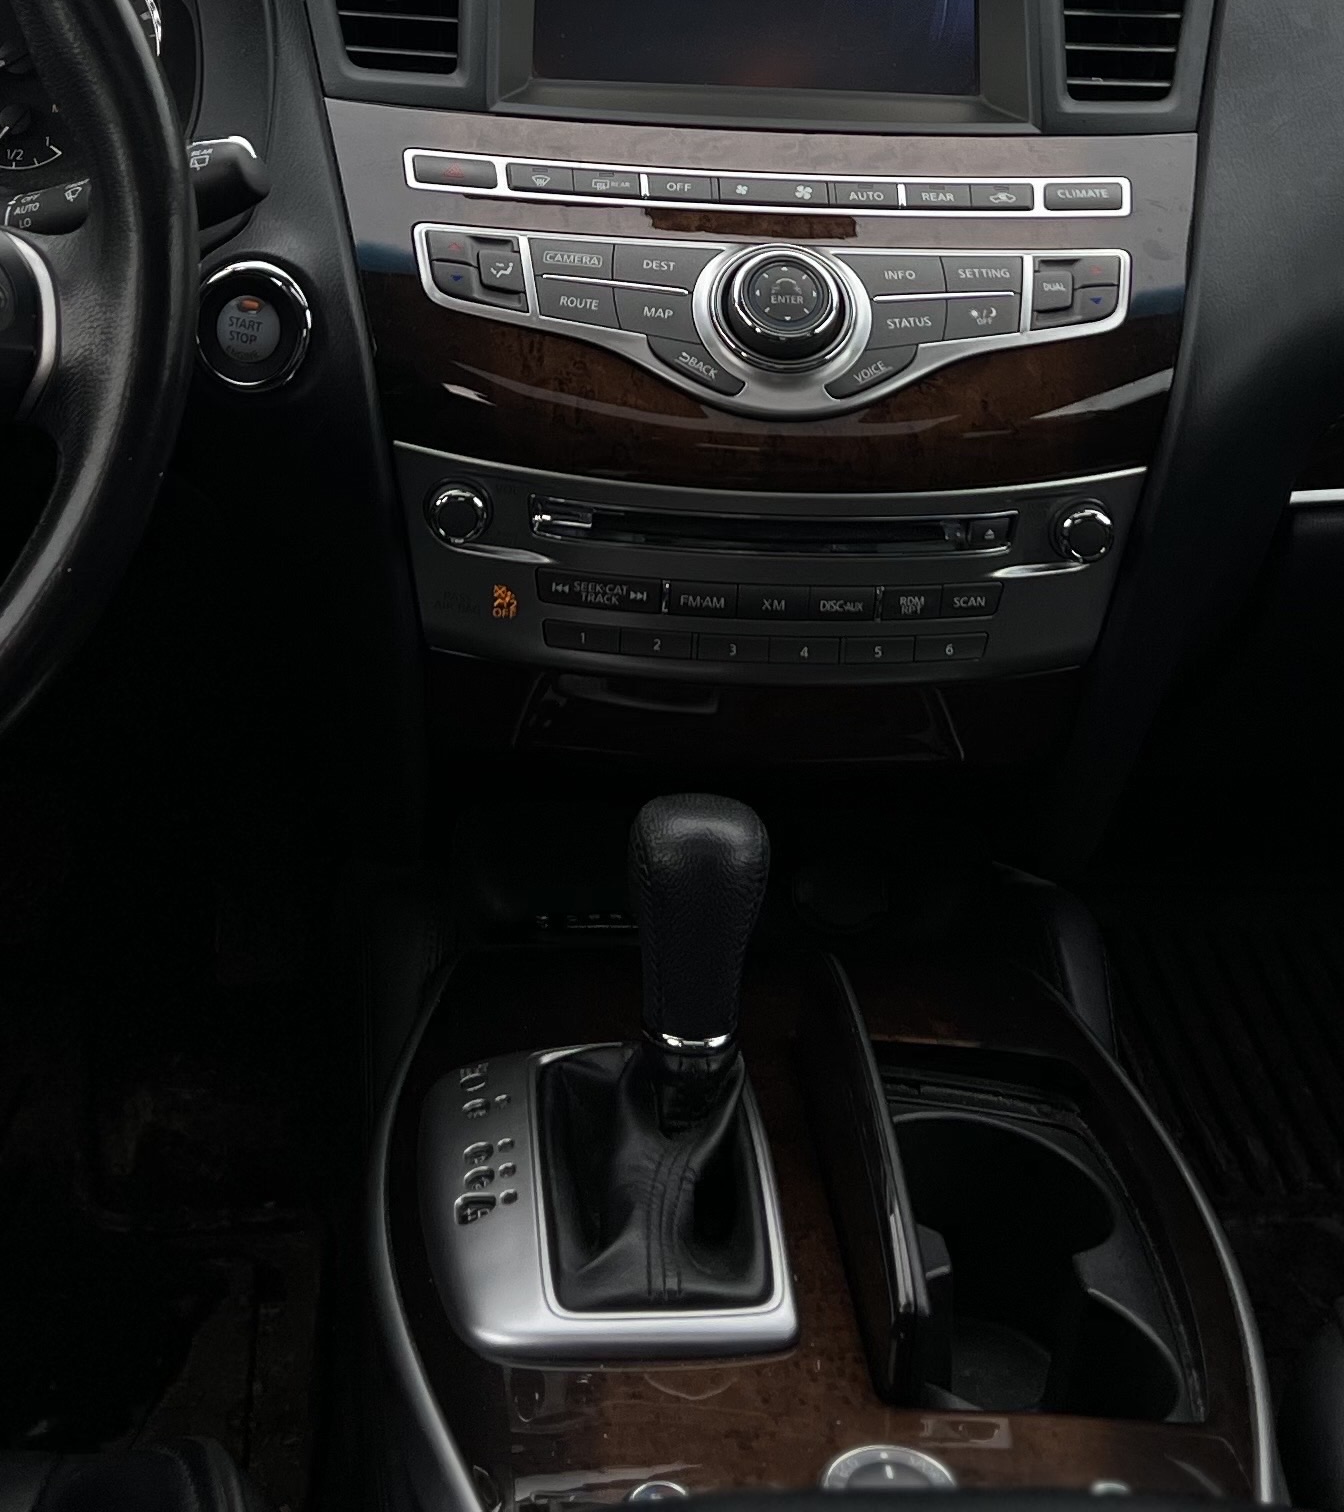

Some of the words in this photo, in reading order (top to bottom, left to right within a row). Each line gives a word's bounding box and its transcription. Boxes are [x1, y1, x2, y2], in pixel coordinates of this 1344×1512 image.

[44, 136, 51, 147] 1
[6, 148, 25, 161] 1/2
[610, 180, 631, 189] REAR
[665, 181, 692, 193] OFF
[848, 190, 885, 202] AUTO
[921, 191, 955, 203] REAR
[1056, 187, 1110, 200] CLIMATE
[13, 202, 40, 216] AUTO
[19, 217, 32, 229] LO
[545, 252, 600, 267] CAMERA
[642, 259, 676, 272] DEST
[883, 269, 916, 281] INFO
[957, 267, 1011, 280] SETTING
[1042, 281, 1066, 292] DUAL
[559, 295, 600, 311] ROUTE
[770, 294, 804, 306] ENTER
[642, 305, 674, 319] MAP
[228, 315, 263, 333] START
[886, 315, 933, 329] STATUS
[976, 316, 994, 326] OFF
[229, 330, 258, 345] STOP
[689, 356, 718, 380] BACK
[853, 360, 887, 383] VOICE
[580, 591, 620, 606] TRACK
[761, 598, 786, 611] XM
[899, 595, 925, 607] RDM
[953, 595, 986, 608] SCAN
[492, 607, 517, 620] OFF
[580, 631, 586, 644] 1
[653, 638, 661, 651] 2
[728, 644, 737, 656] 3
[873, 645, 883, 657] 5
[945, 643, 954, 656] 6
[799, 646, 809, 658] 4
